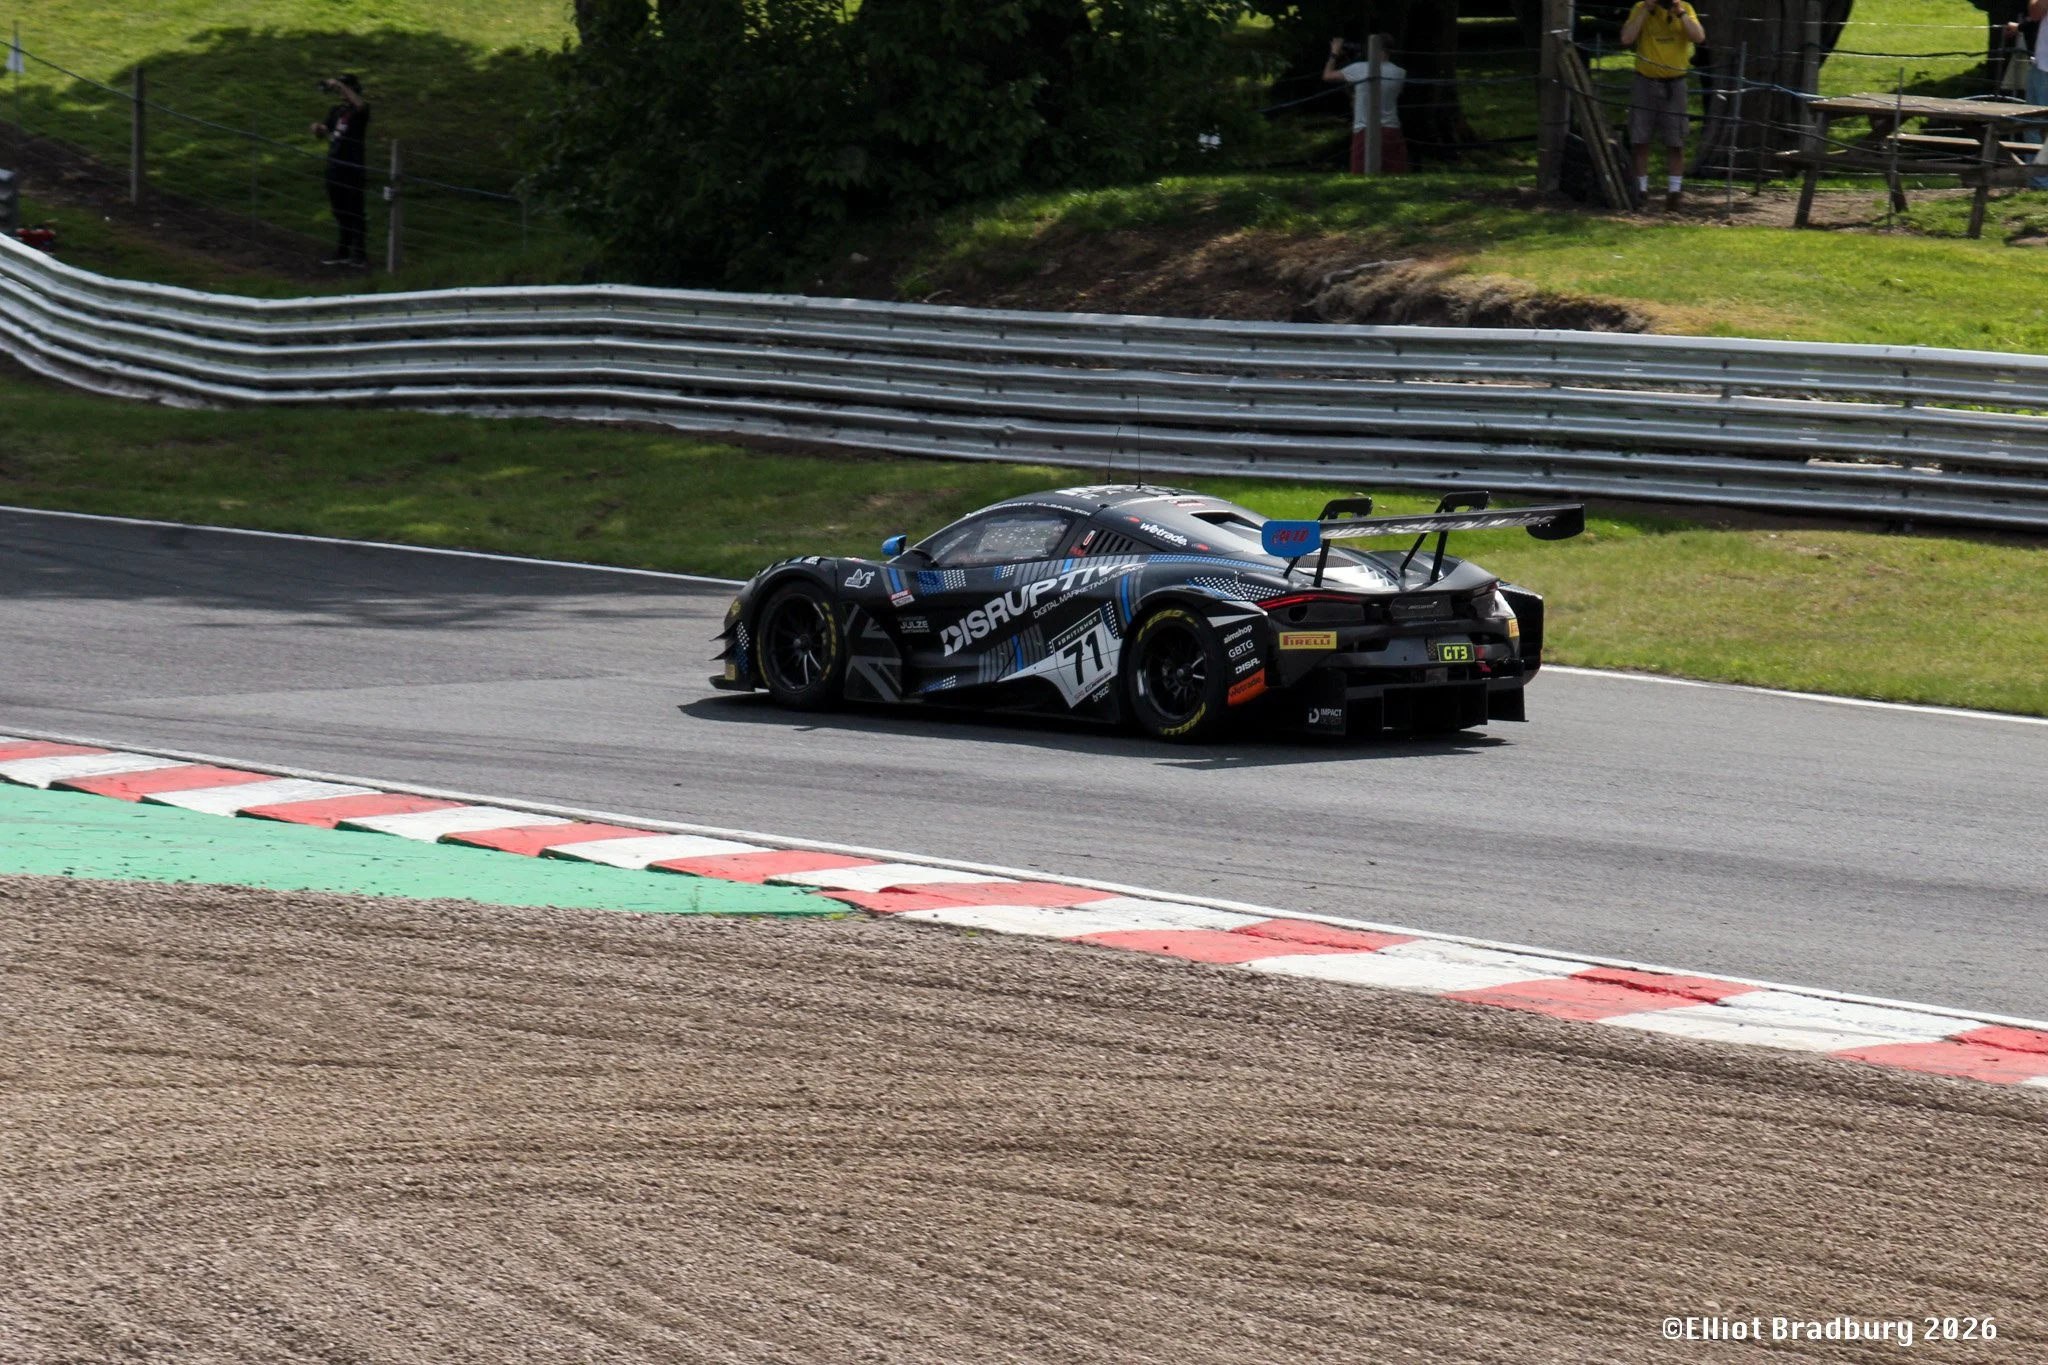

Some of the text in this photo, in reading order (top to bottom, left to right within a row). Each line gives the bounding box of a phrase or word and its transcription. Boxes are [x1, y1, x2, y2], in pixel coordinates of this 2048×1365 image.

[1033, 599, 1060, 619] DIGITAL
[1059, 576, 1108, 604] MARKETING
[1224, 624, 1253, 644] aimshop
[1283, 634, 1331, 646] PIRELLI
[1063, 630, 1104, 686] 71
[1228, 640, 1254, 658] GBTG
[1443, 645, 1468, 660] GT3
[1320, 708, 1342, 717] IMPACT
